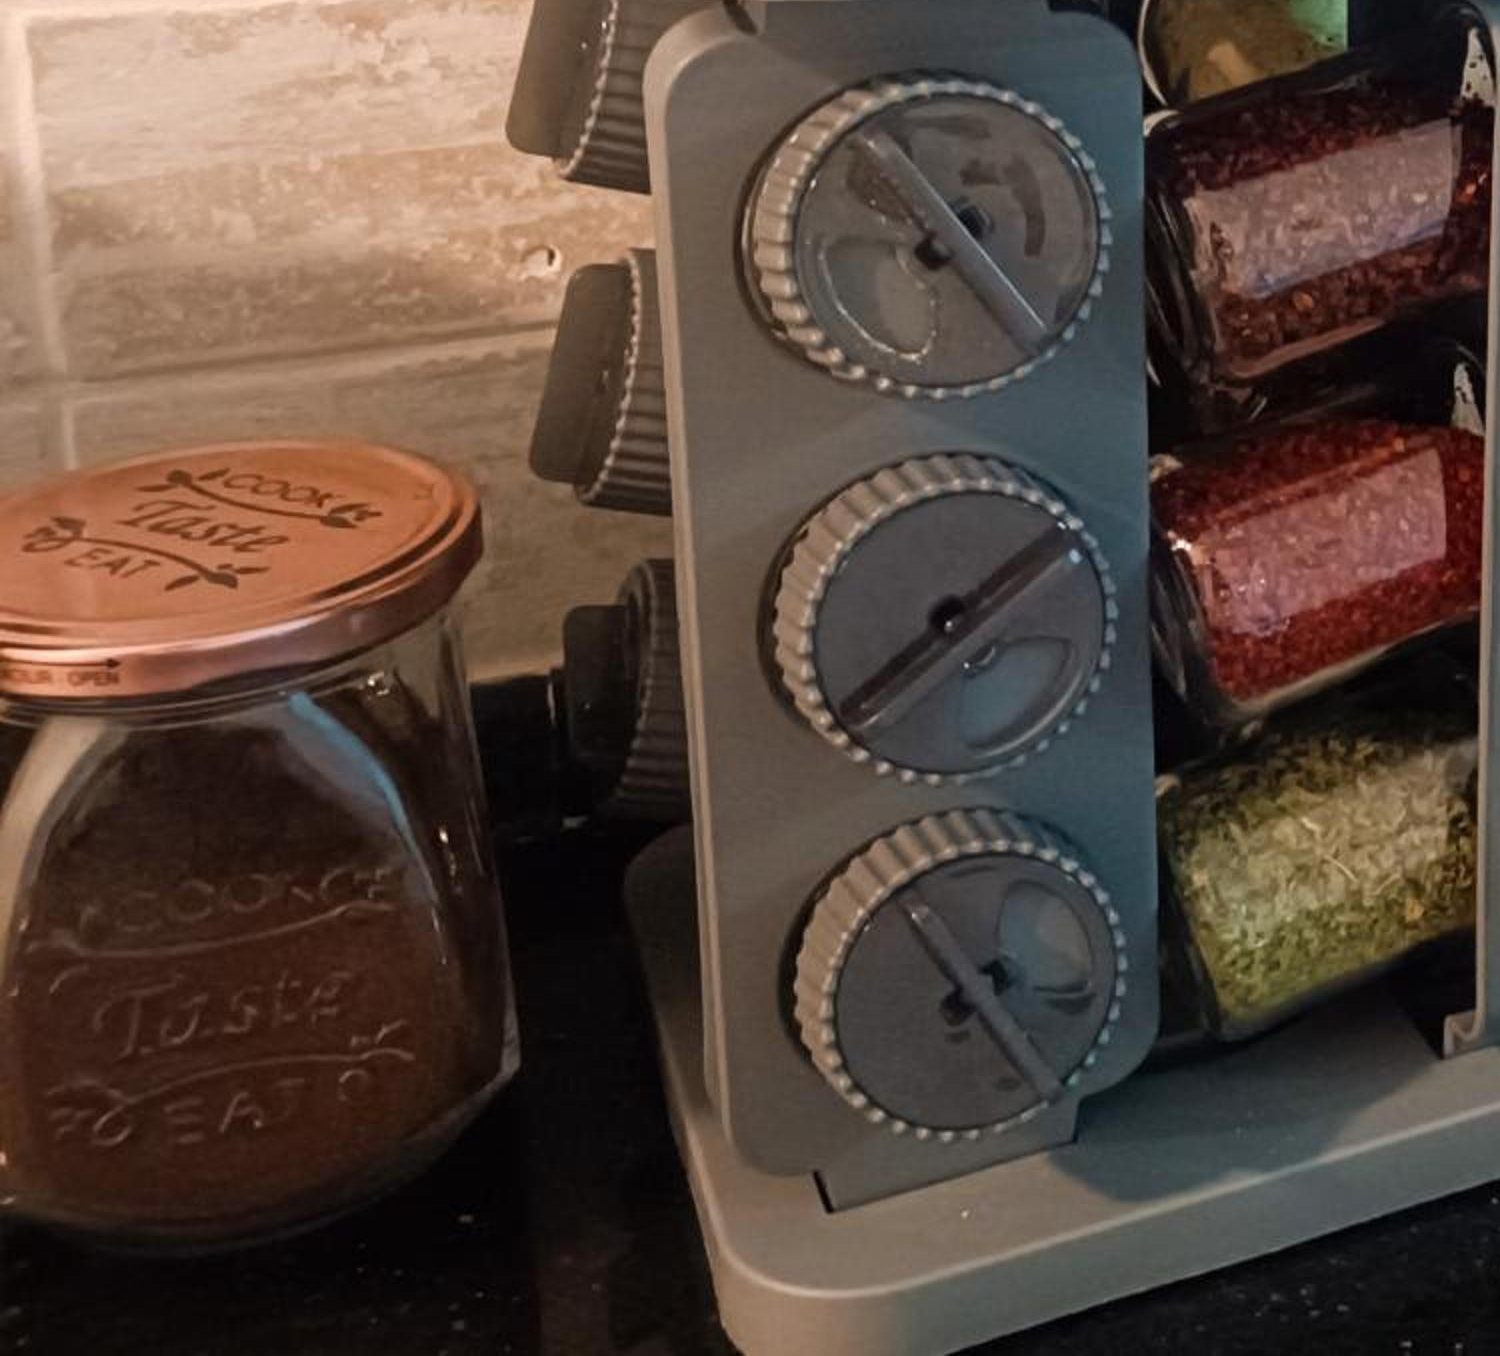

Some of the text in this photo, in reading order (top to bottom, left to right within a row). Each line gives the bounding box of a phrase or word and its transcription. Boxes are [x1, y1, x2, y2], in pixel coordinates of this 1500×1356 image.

[224, 472, 334, 509] COOK
[115, 498, 290, 554] Taste
[63, 546, 164, 579] EAT
